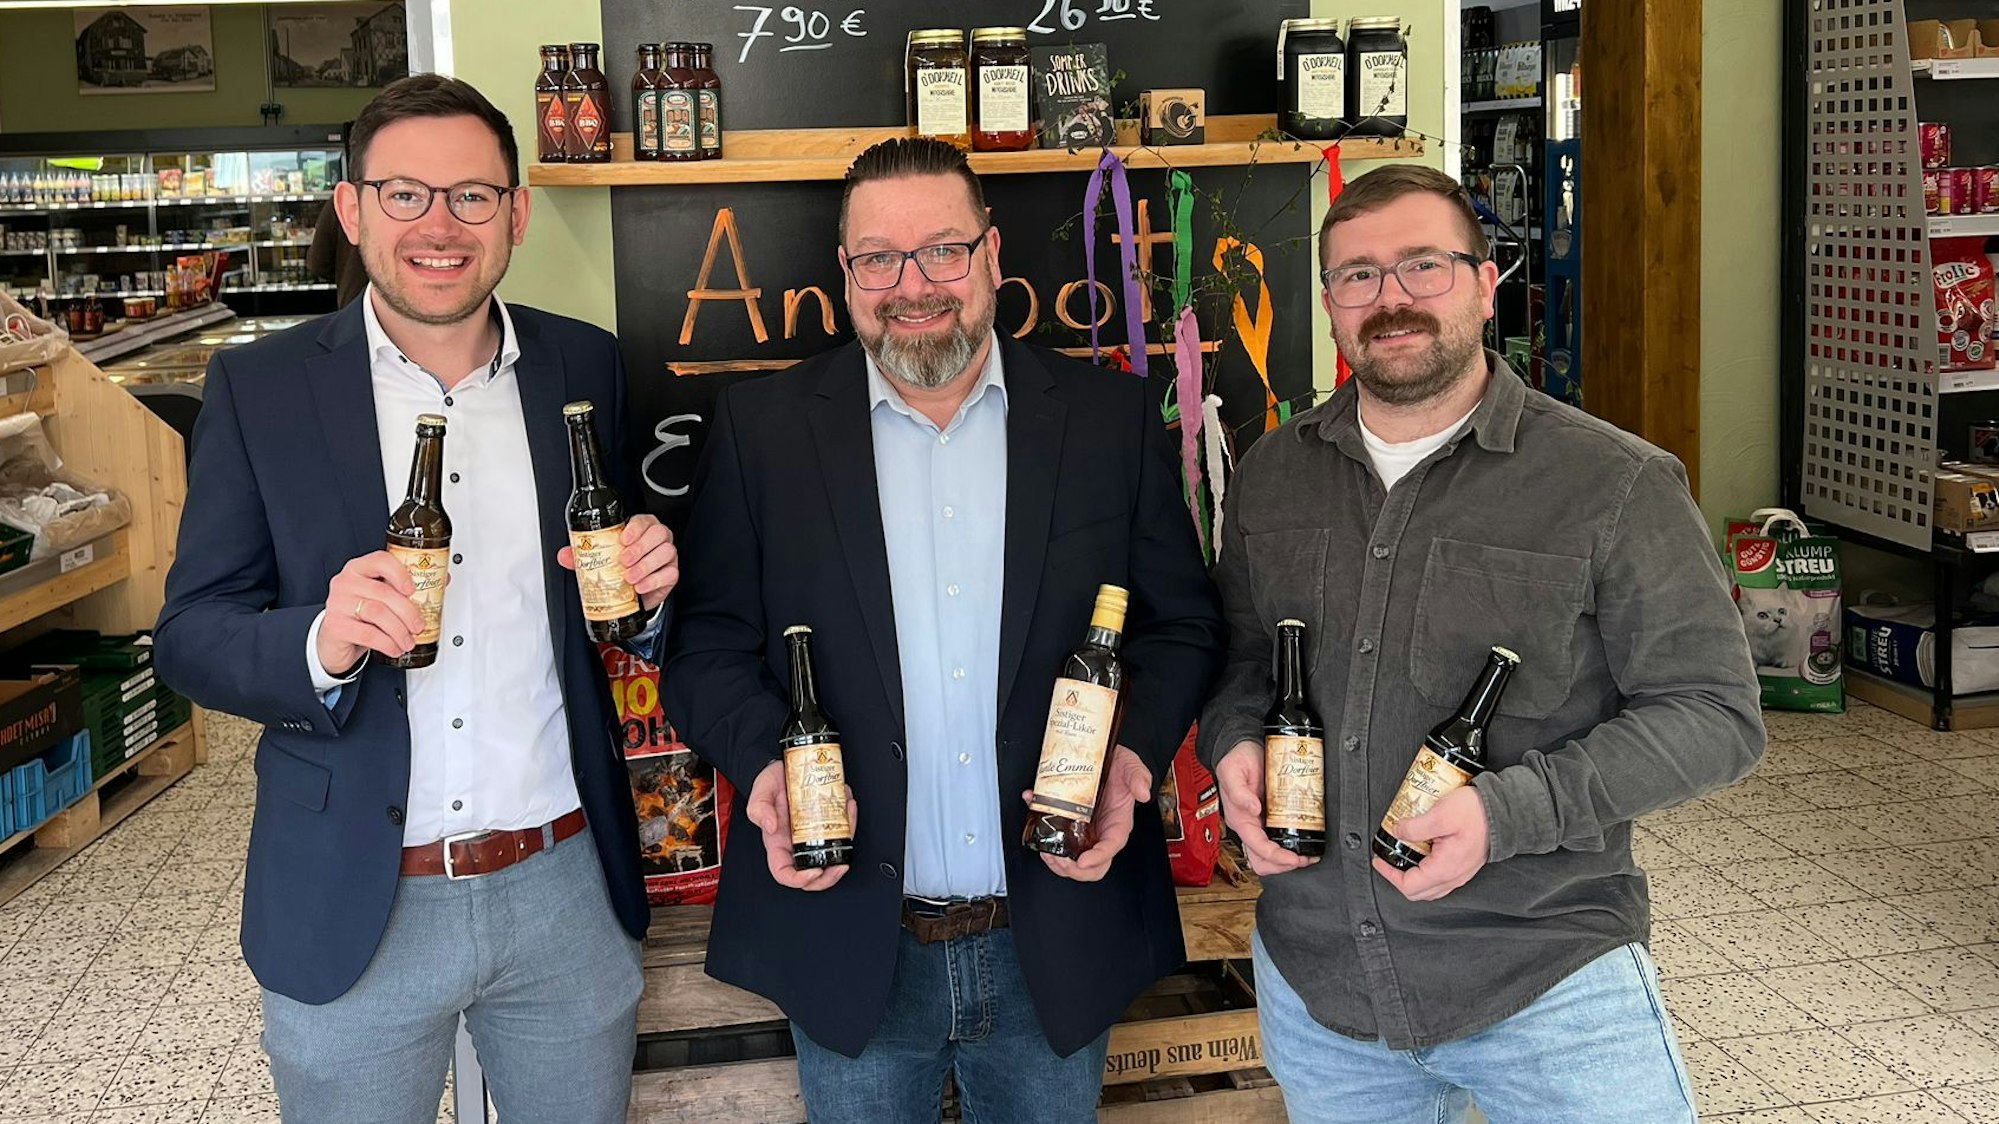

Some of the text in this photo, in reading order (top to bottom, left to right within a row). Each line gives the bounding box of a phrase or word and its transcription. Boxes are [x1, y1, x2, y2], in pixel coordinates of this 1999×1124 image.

[840, 9, 868, 37] €
[1045, 67, 1099, 96] DRINKS
[579, 118, 598, 127] BBQ
[1776, 558, 1835, 574] STREU
[1878, 626, 1892, 675] STREU
[1056, 757, 1095, 773] Emma
[1167, 1043, 1203, 1064] aus
[1207, 1035, 1259, 1062] Wein
